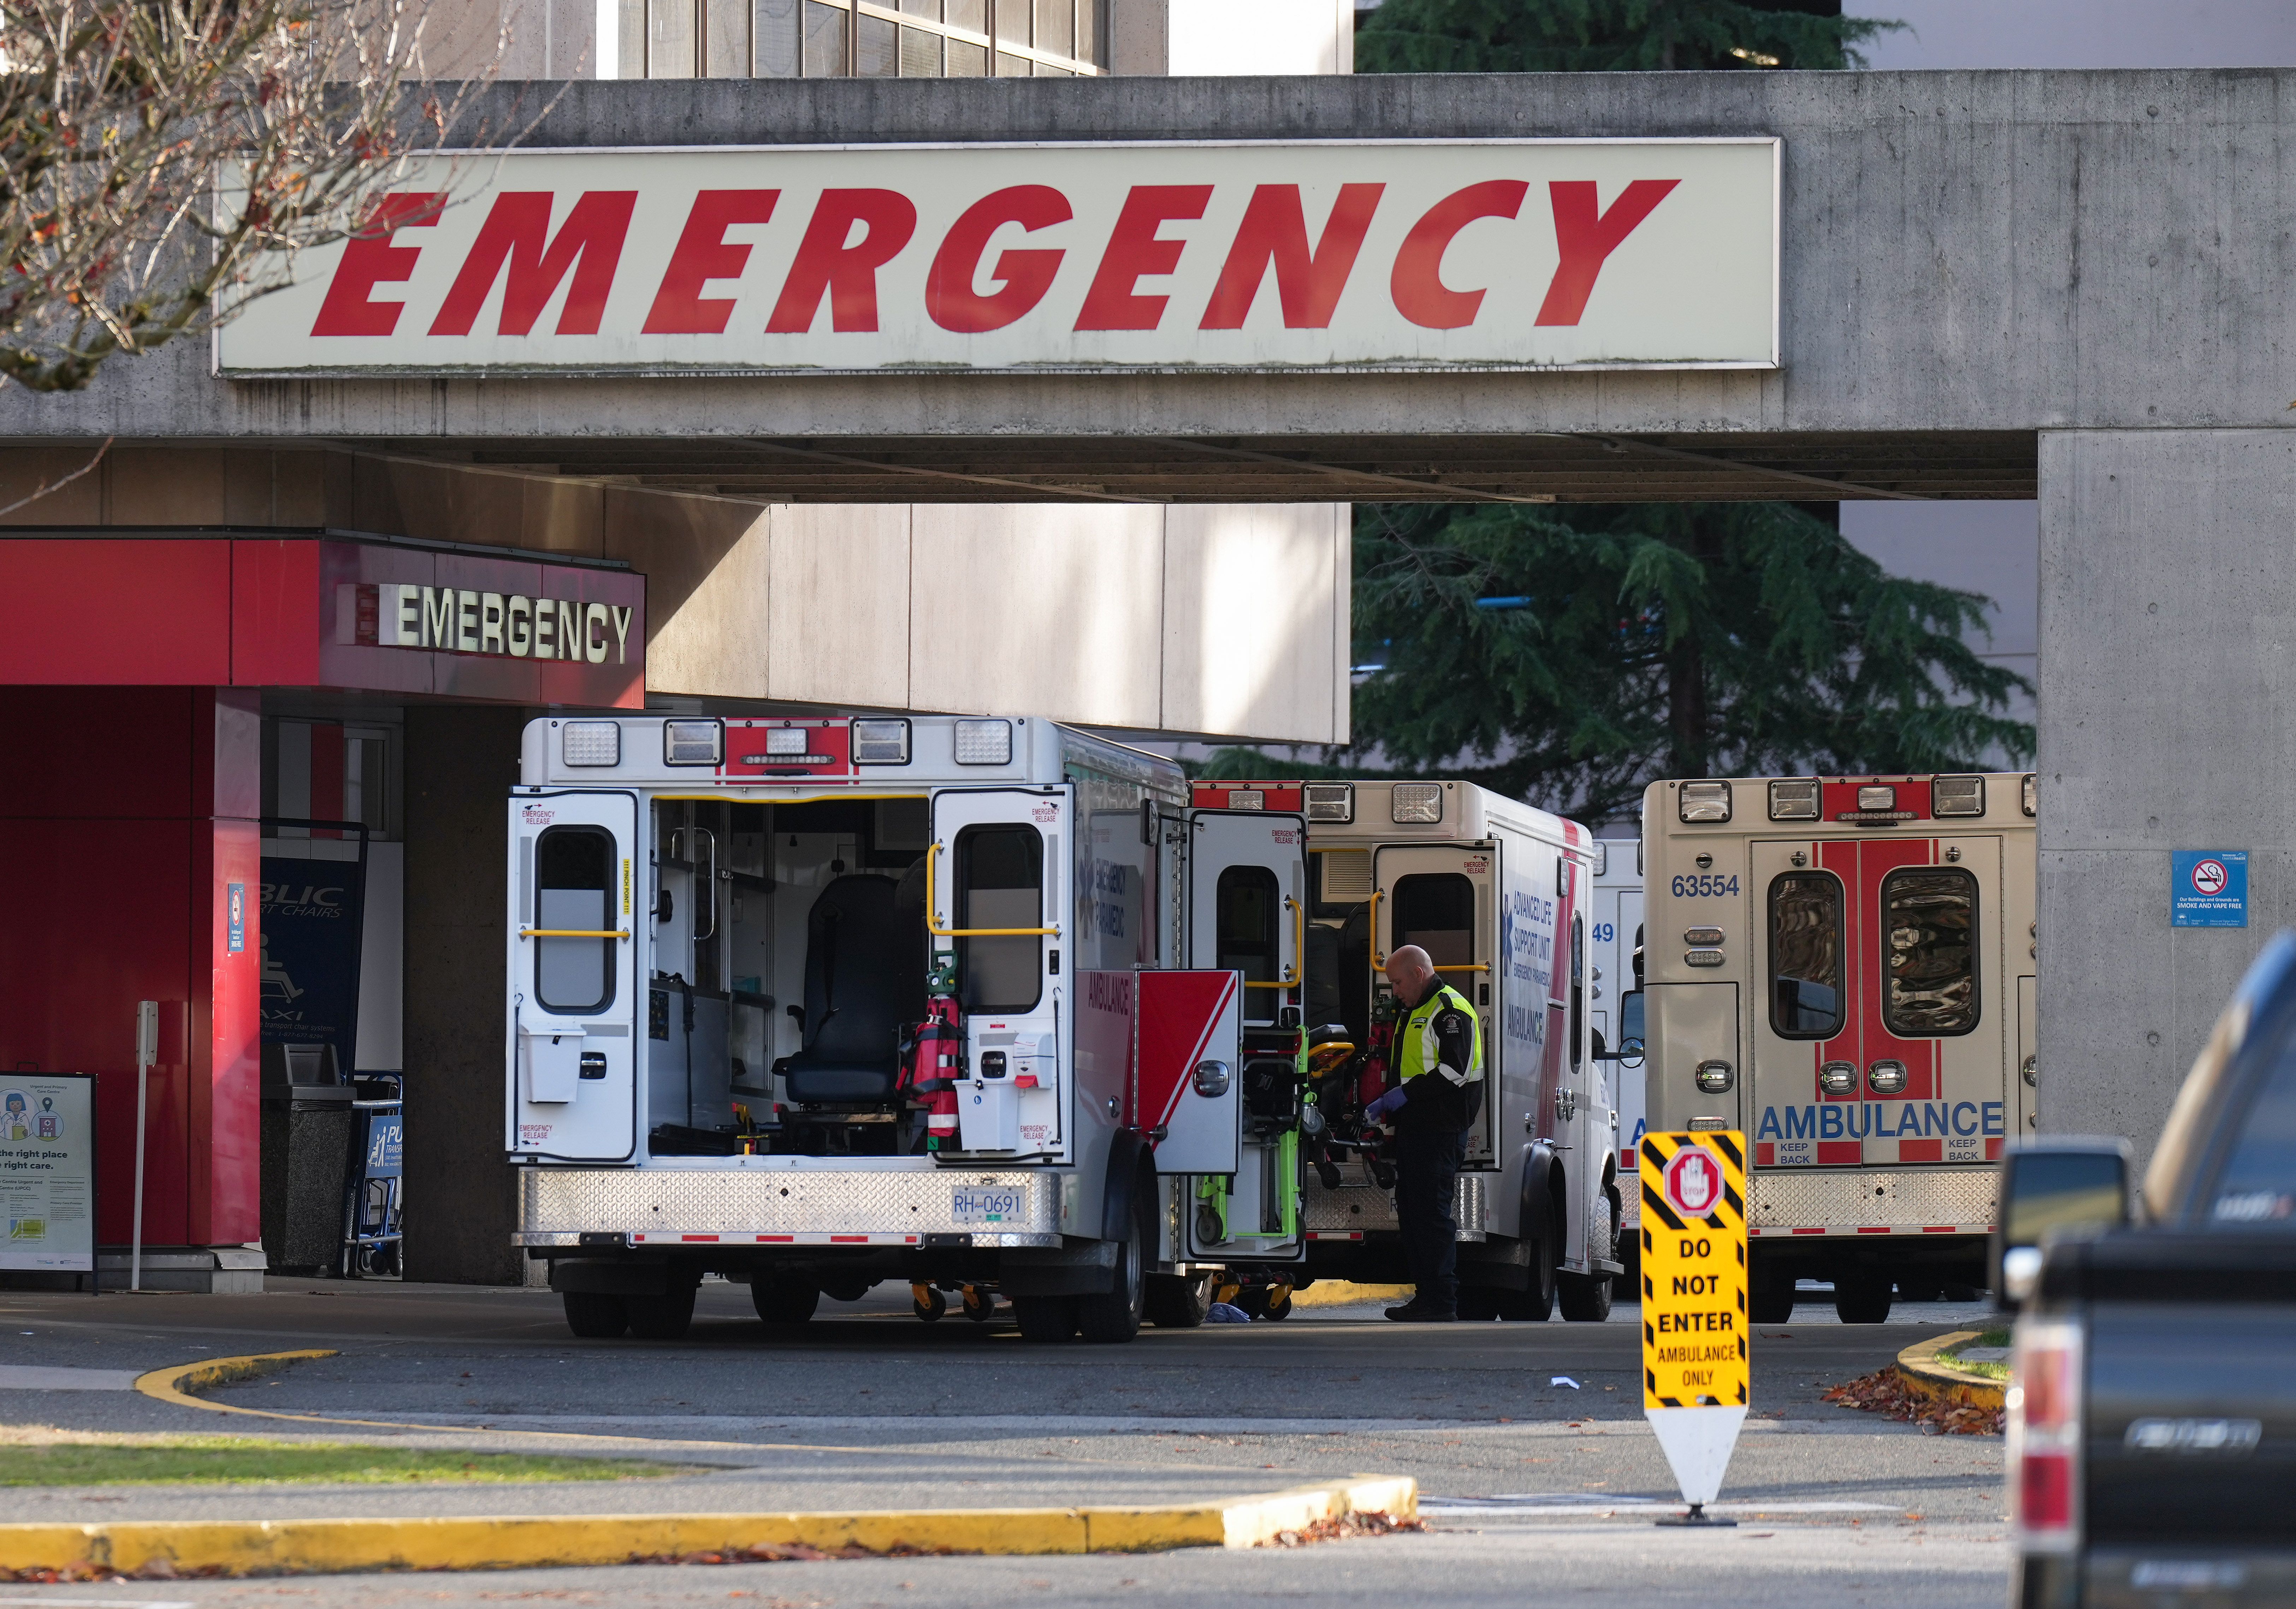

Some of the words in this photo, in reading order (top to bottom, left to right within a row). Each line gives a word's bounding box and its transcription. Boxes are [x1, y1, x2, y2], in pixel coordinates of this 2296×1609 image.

[310, 179, 1680, 336] EMERGENCY
[398, 584, 633, 664] EMERGENCY
[1671, 875, 1739, 897] 63554
[282, 906, 343, 918] CHAIRS
[1514, 890, 1540, 922] ADVANCED
[1541, 898, 1551, 926] LIFE
[1514, 927, 1538, 956] SUPPORT
[1538, 935, 1550, 961] UNIT
[1514, 962, 1532, 982] EMERGENCY
[1532, 967, 1550, 987] PARAMEDIC
[1089, 971, 1128, 1016] AMBULANCE
[1508, 1004, 1542, 1045] AMBULANCE
[1757, 1102, 2003, 1139] AMBULANCE
[385, 1144, 402, 1153] TRANSP
[1780, 1143, 1807, 1152] KEEP
[1948, 1139, 1976, 1148] KEEP
[16, 1150, 40, 1159] right
[42, 1151, 68, 1159] place
[1780, 1155, 1810, 1164] BACK
[1949, 1152, 1978, 1160] BACK
[4, 1161, 28, 1170] right
[1683, 1187, 1705, 1197] STOP
[1680, 1239, 1711, 1258] DO
[1673, 1276, 1719, 1295] NOT
[1659, 1312, 1733, 1332] ENTER
[1657, 1344, 1735, 1363] AMBULANCE
[1682, 1369, 1714, 1387] ONLY
